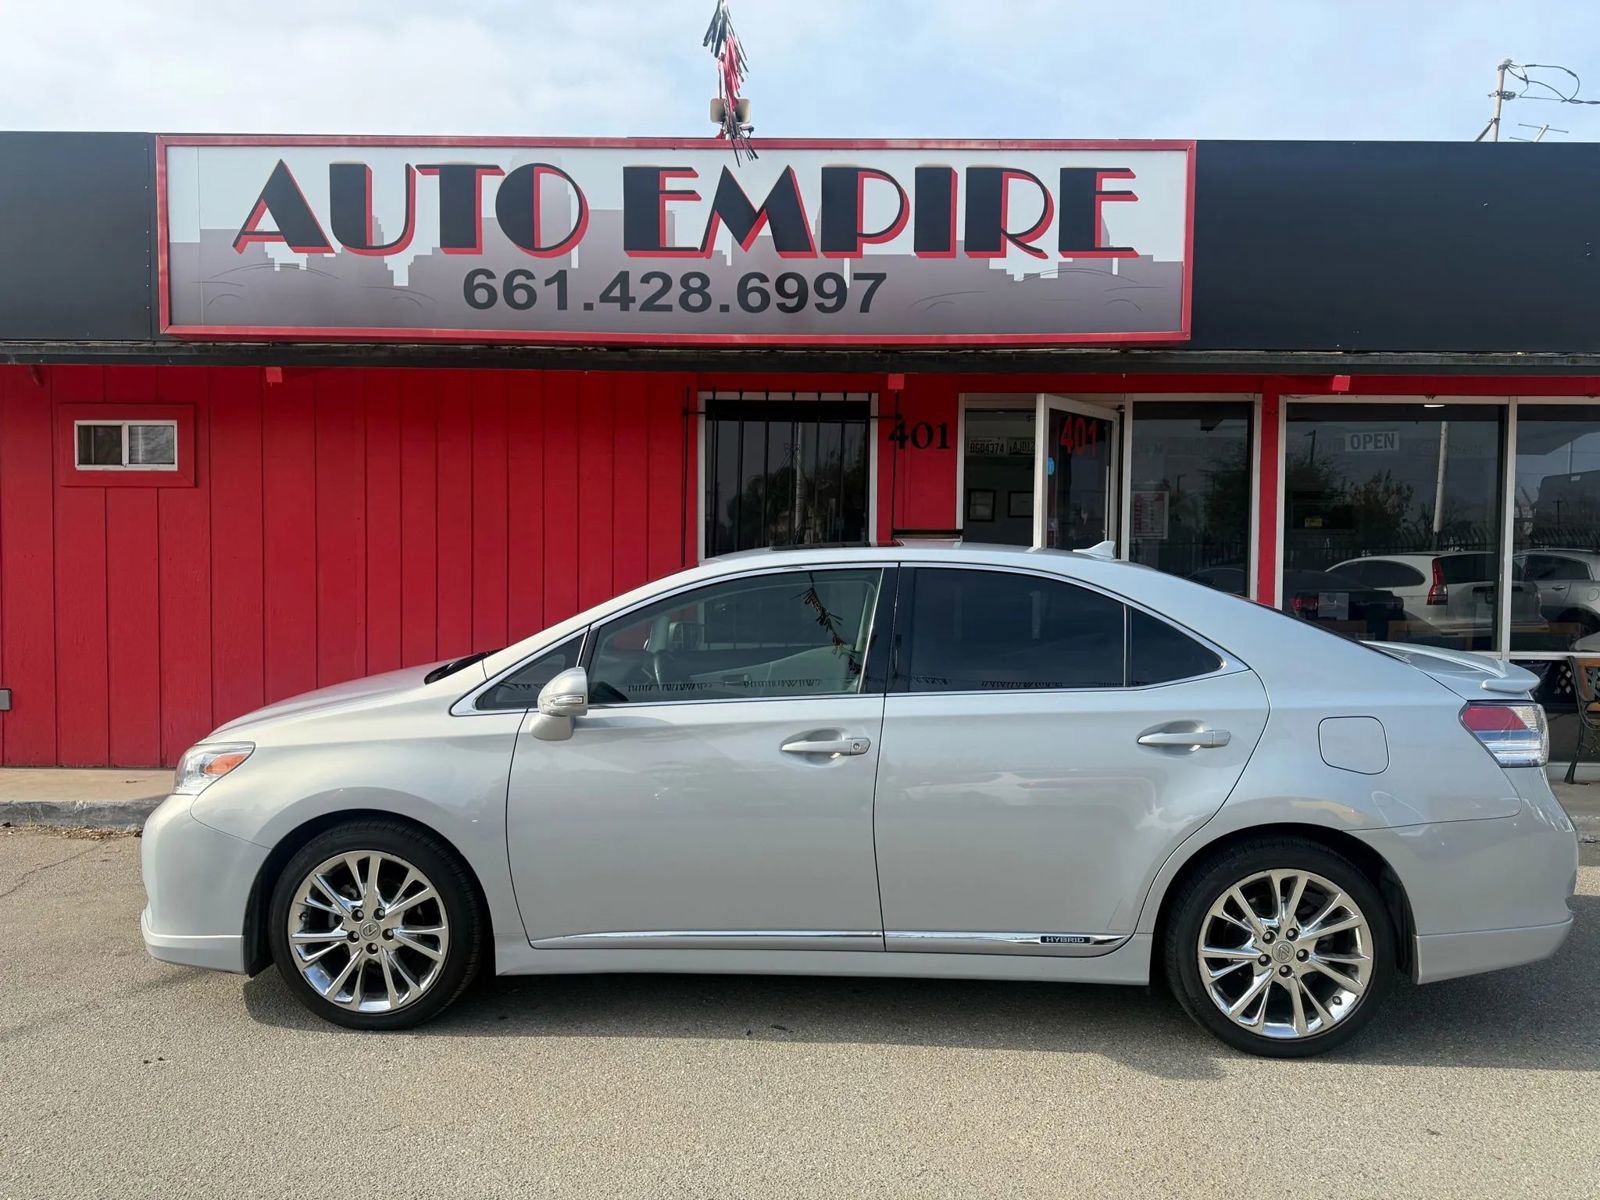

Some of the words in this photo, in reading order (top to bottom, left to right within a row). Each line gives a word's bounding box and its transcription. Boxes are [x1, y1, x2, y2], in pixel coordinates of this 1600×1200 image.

[232, 158, 590, 259] AUTO
[623, 163, 1140, 260] EMPIRE
[463, 267, 888, 314] 661.428.6997
[888, 421, 951, 450] 401
[1060, 415, 1097, 456] 401
[1350, 433, 1395, 450] OPEN
